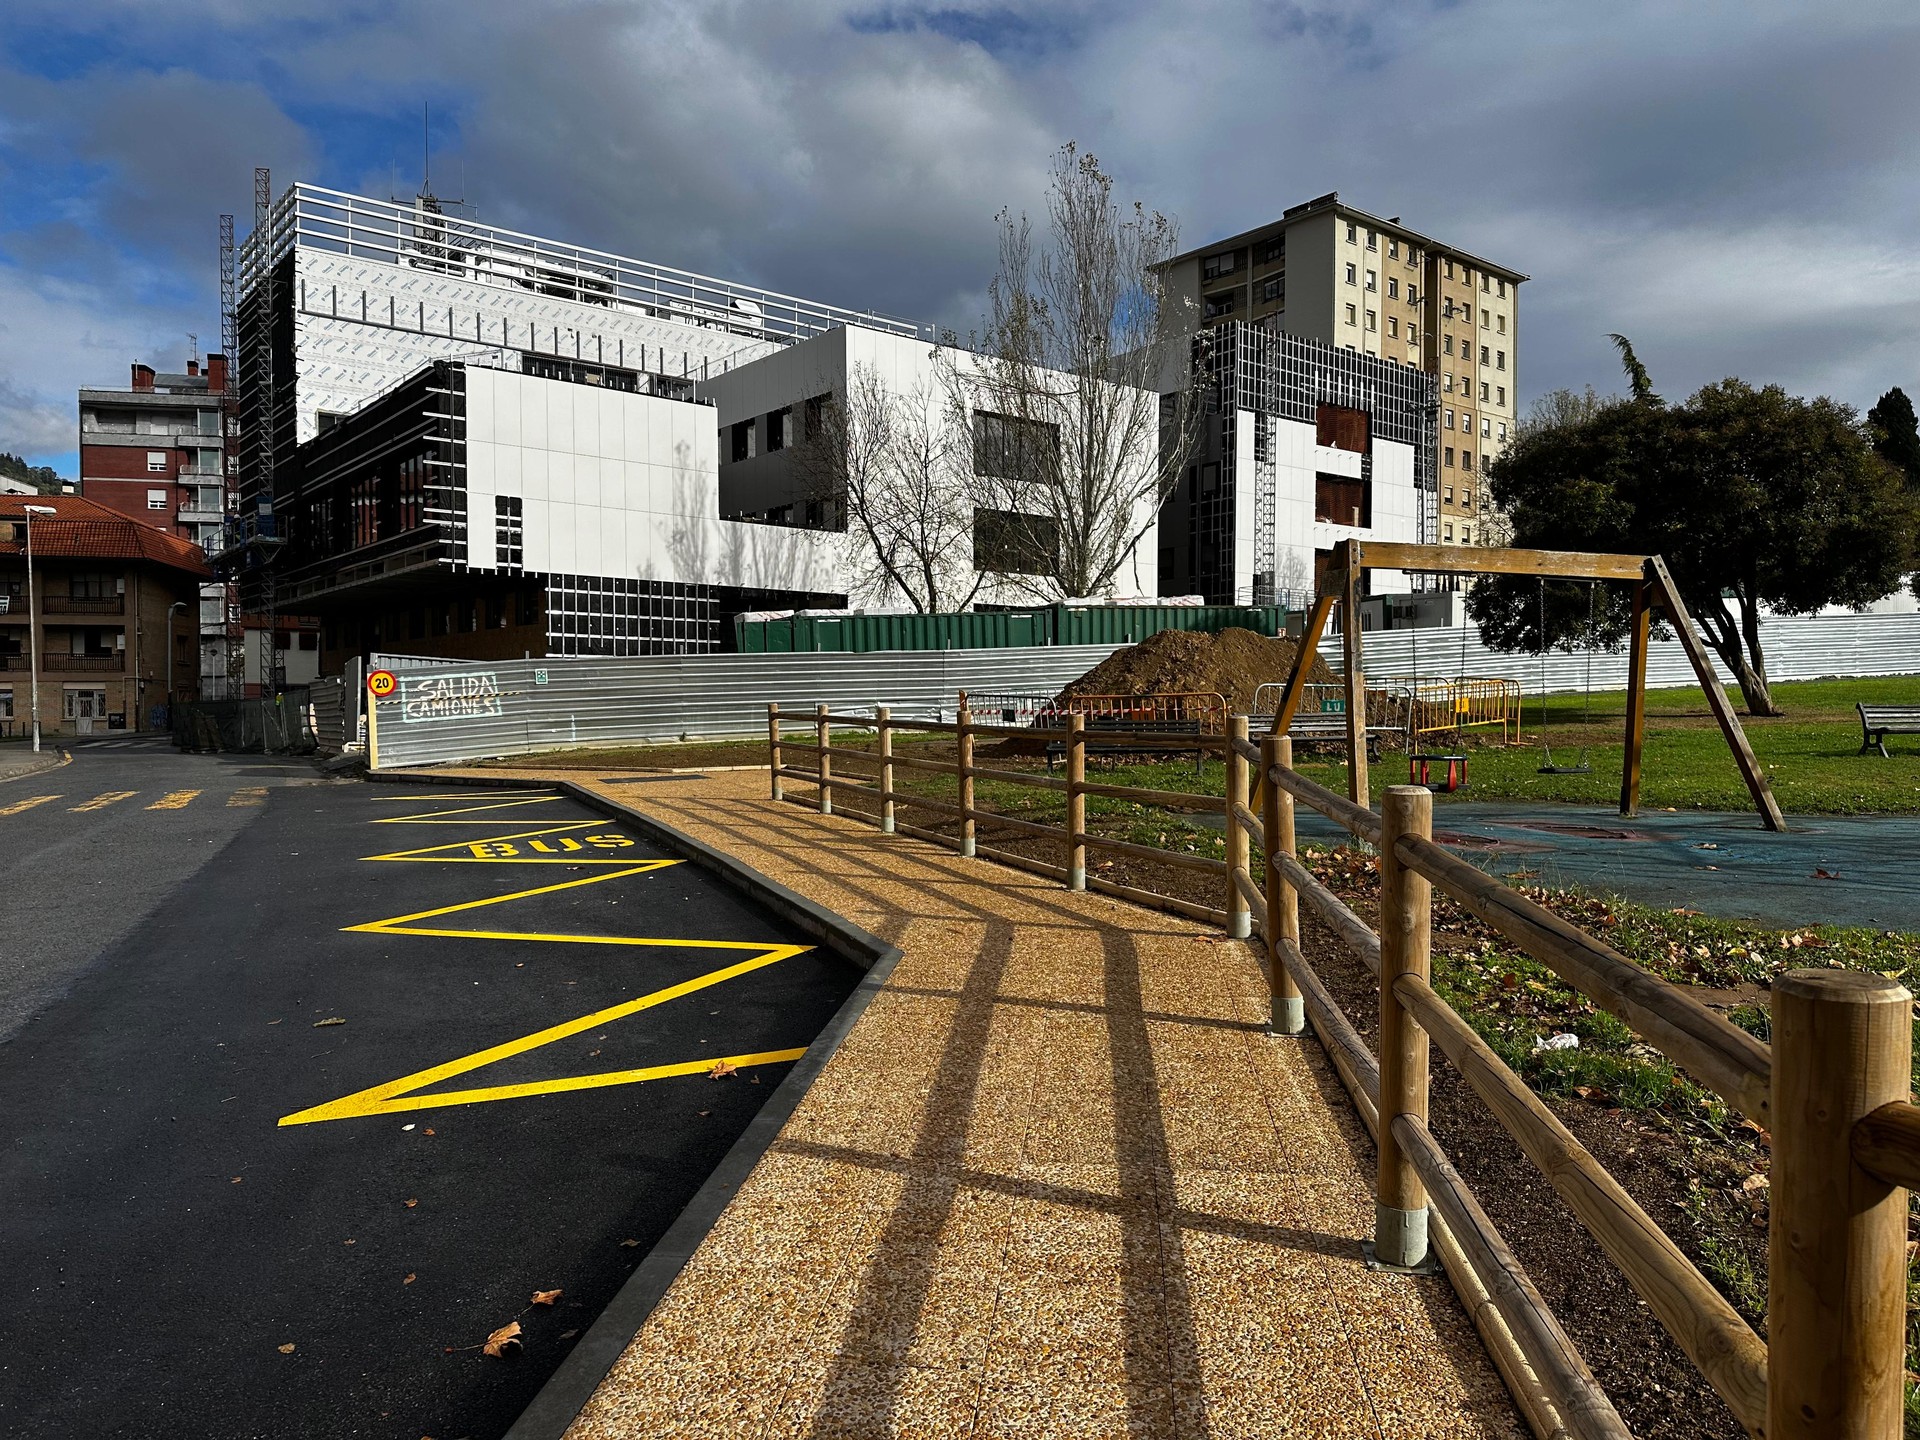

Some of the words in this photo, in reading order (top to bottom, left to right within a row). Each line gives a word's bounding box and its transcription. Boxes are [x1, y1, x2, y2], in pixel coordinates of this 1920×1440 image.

[375, 678, 390, 688] 20
[417, 676, 494, 700] SALIDA
[407, 697, 495, 717] CAMIONES
[468, 834, 635, 858] BUS
